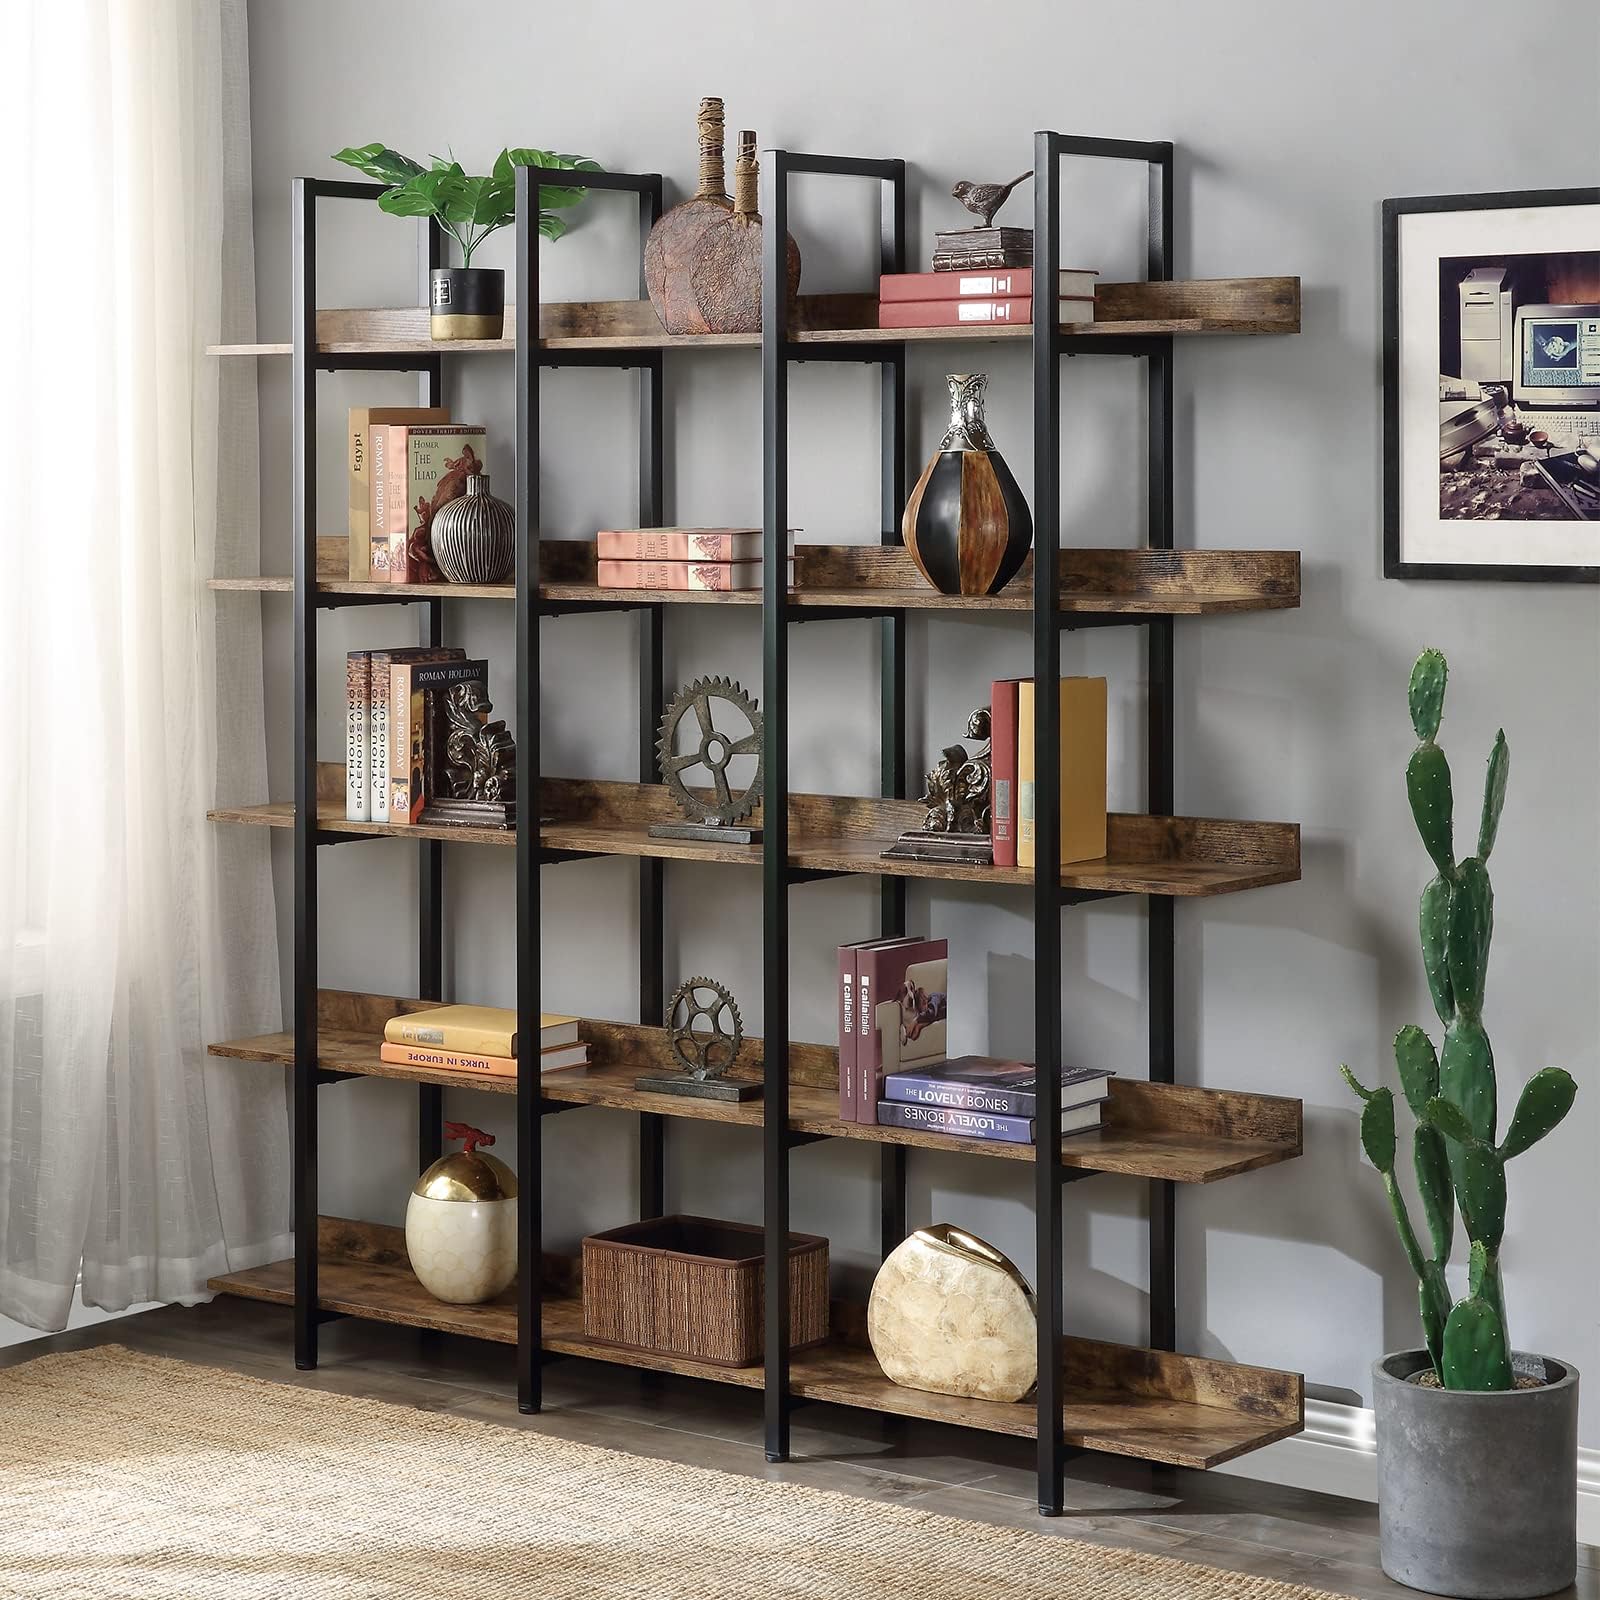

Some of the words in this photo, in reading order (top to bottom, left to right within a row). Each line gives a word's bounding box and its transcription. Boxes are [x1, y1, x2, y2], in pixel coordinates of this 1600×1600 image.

[354, 432, 364, 472] Egypt
[375, 436, 384, 475] ROMAN
[414, 451, 431, 465] THE
[375, 481, 384, 529] HOLIDAY
[419, 671, 447, 681] ROMAN
[448, 668, 481, 679] HOLIDAY
[396, 676, 405, 715] ROMAN
[396, 721, 405, 770] HOLIDAY
[408, 1053, 443, 1063] EUROPE
[447, 1058, 458, 1066] IN
[460, 1059, 490, 1069] TURKS
[905, 1088, 917, 1096] THE
[918, 1090, 965, 1105] LOVELY
[967, 1096, 1009, 1111] BONES
[904, 1107, 945, 1124] BONES
[948, 1114, 995, 1130] LOVELY
[996, 1123, 1009, 1132] THE
